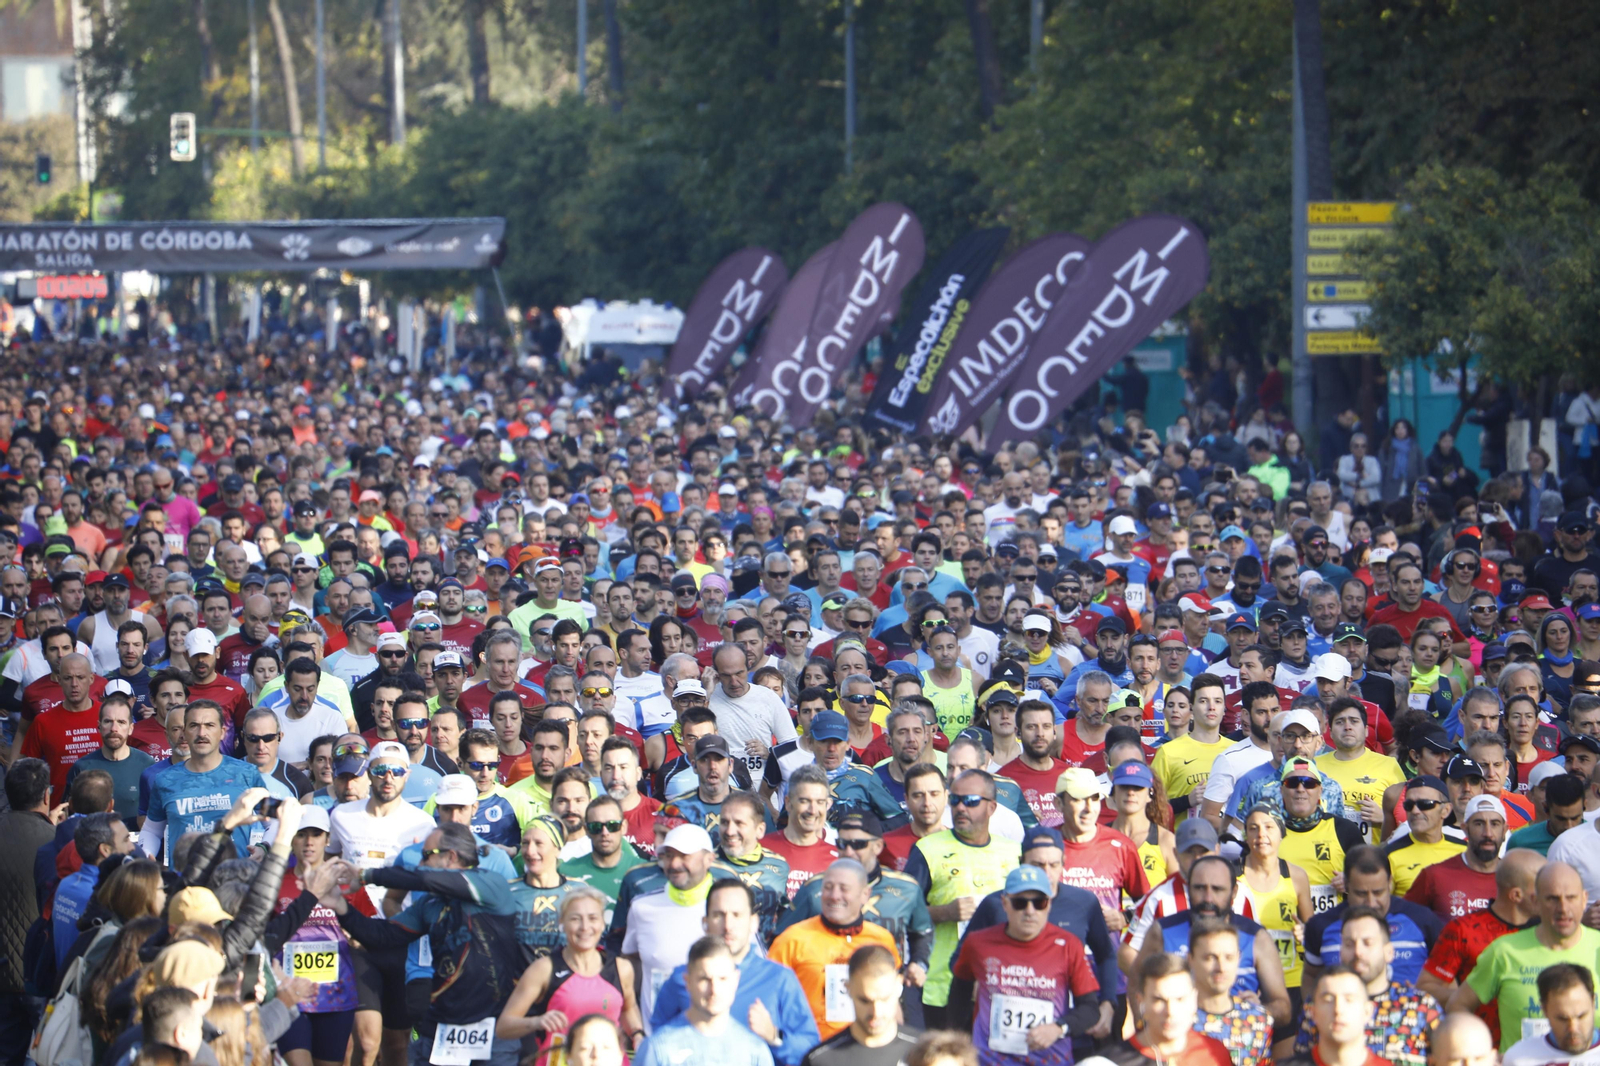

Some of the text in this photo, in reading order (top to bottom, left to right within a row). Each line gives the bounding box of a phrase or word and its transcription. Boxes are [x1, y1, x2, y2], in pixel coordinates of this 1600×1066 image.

[104, 231, 133, 249] DE
[140, 228, 253, 249] CÓRDOBA
[35, 253, 93, 267] SALIDA
[1007, 226, 1191, 432] IMDECO
[888, 273, 966, 408] Especolchón
[916, 298, 970, 394] exclusive
[72, 727, 98, 735] CARRERA
[64, 741, 100, 751] AUXILIADORA
[175, 797, 193, 815] VI
[1062, 867, 1096, 878] MEDIA
[1062, 876, 1114, 888] MARATÓN
[1450, 905, 1465, 917] 36
[293, 952, 335, 970] 3062
[1001, 965, 1036, 978] MEDIA
[1001, 975, 1057, 989] MARATÓN
[446, 1028, 489, 1045] 4064
